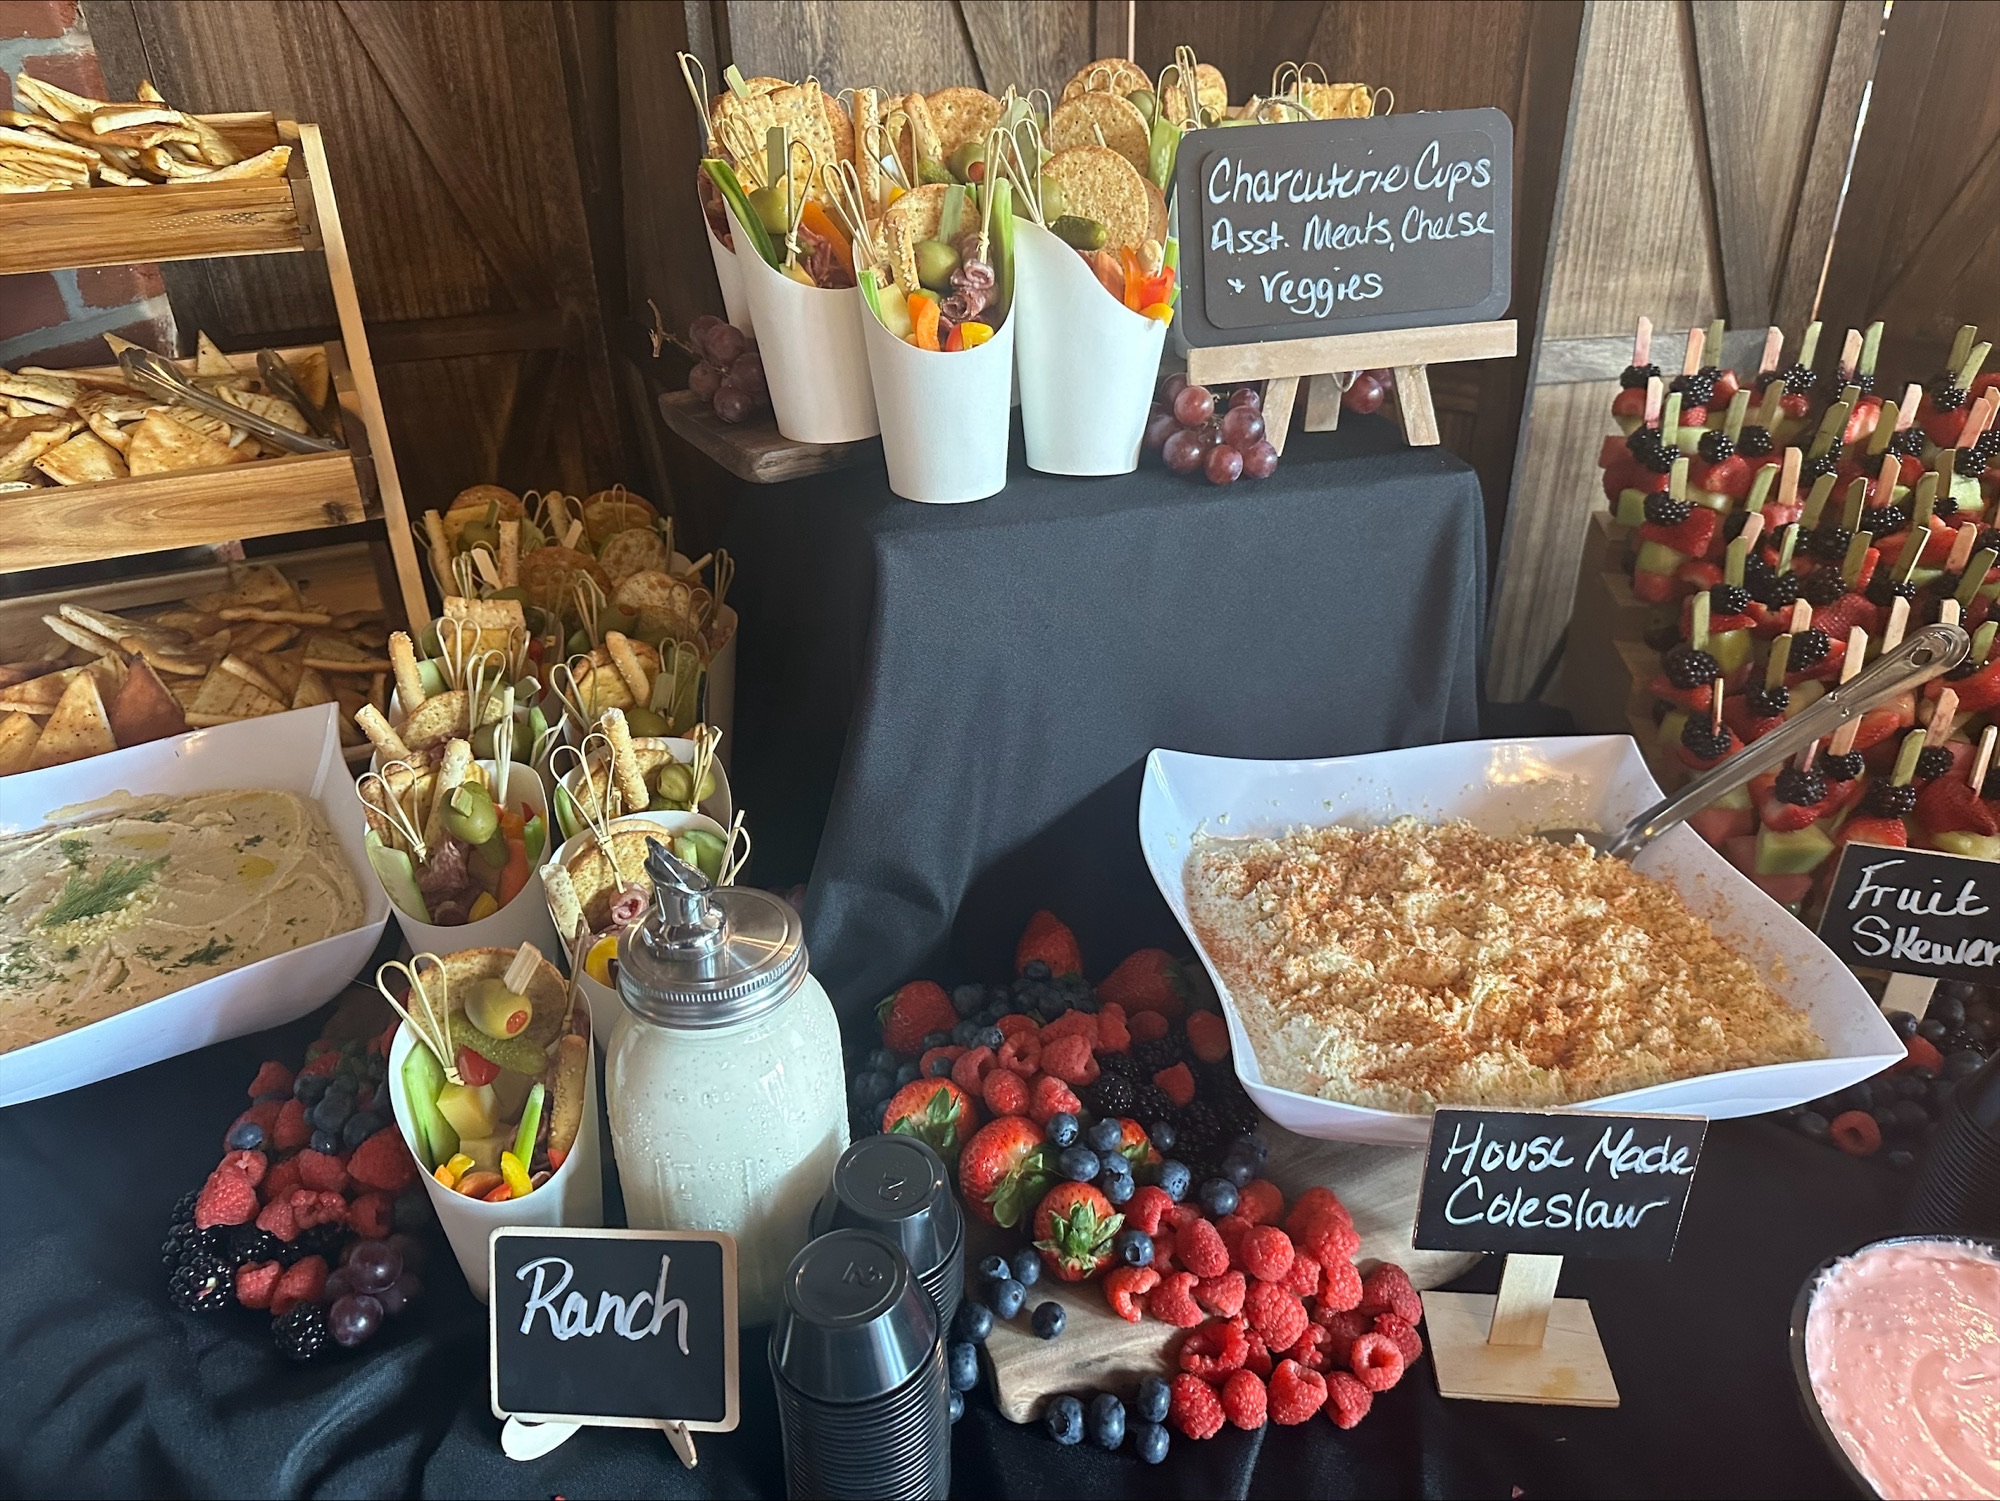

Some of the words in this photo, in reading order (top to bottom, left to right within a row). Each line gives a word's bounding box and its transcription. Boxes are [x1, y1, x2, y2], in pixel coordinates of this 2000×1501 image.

[1413, 140, 1491, 202] Cups
[1401, 205, 1495, 244] Cheese
[1847, 859, 1990, 916] Fruit
[1441, 1122, 1574, 1176] House
[1584, 1126, 1694, 1179] Made
[1444, 1175, 1669, 1232] Coleslaw
[515, 1253, 690, 1356] Ranch
